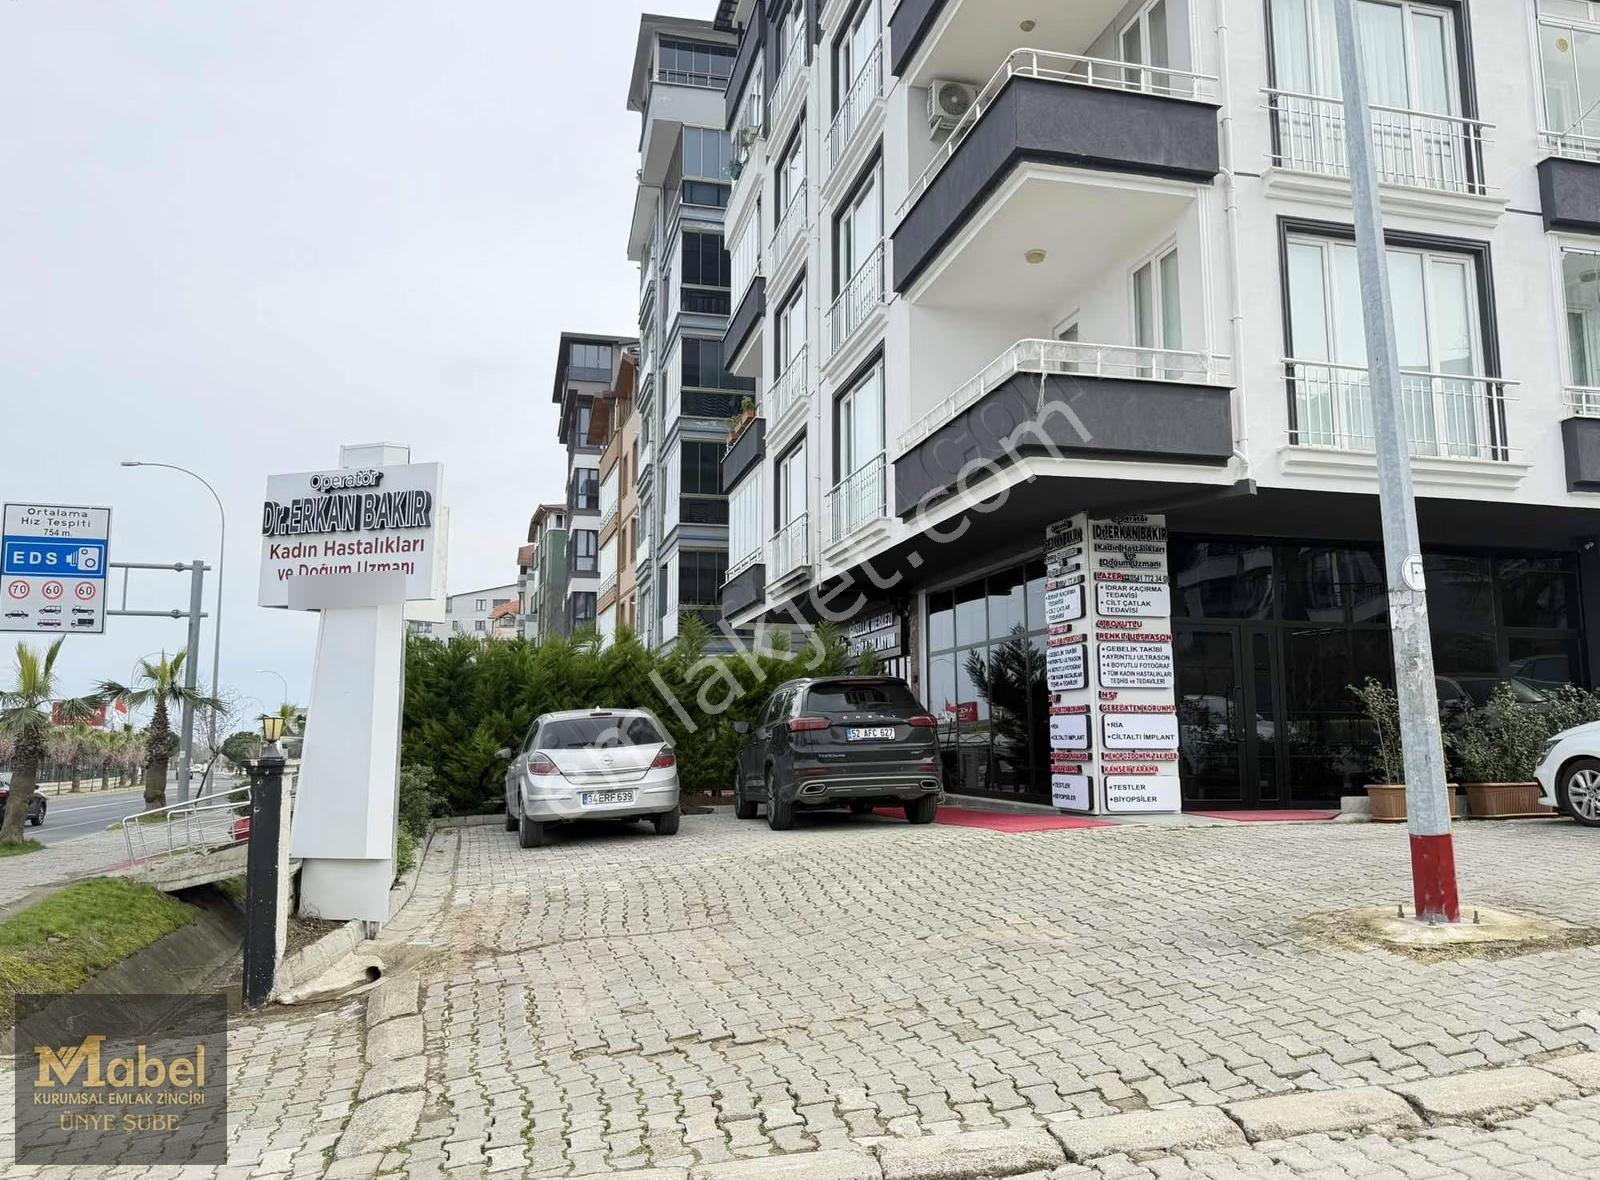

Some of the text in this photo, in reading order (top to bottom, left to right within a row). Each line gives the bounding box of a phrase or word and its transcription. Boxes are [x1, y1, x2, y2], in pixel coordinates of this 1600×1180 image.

[310, 470, 384, 493] Operatör
[27, 507, 88, 518] Ortalama
[262, 490, 432, 537] Dr.ERKAN BAKIR
[48, 518, 91, 528] Tespiti
[44, 528, 59, 536] 754
[1139, 526, 1168, 542] BAKIR
[270, 536, 425, 559] Kadın Hastalıkları
[13, 551, 58, 565] EDS
[278, 568, 293, 581] ve
[13, 585, 92, 595] 70 60 60
[1105, 620, 1143, 629] BOYUTLU
[1129, 633, 1173, 643] ULTRASON
[1099, 690, 1118, 700] NST
[851, 729, 893, 737] 52 AFC 627
[1131, 766, 1159, 775] TARAMA
[588, 792, 633, 804] 34 ERF 639
